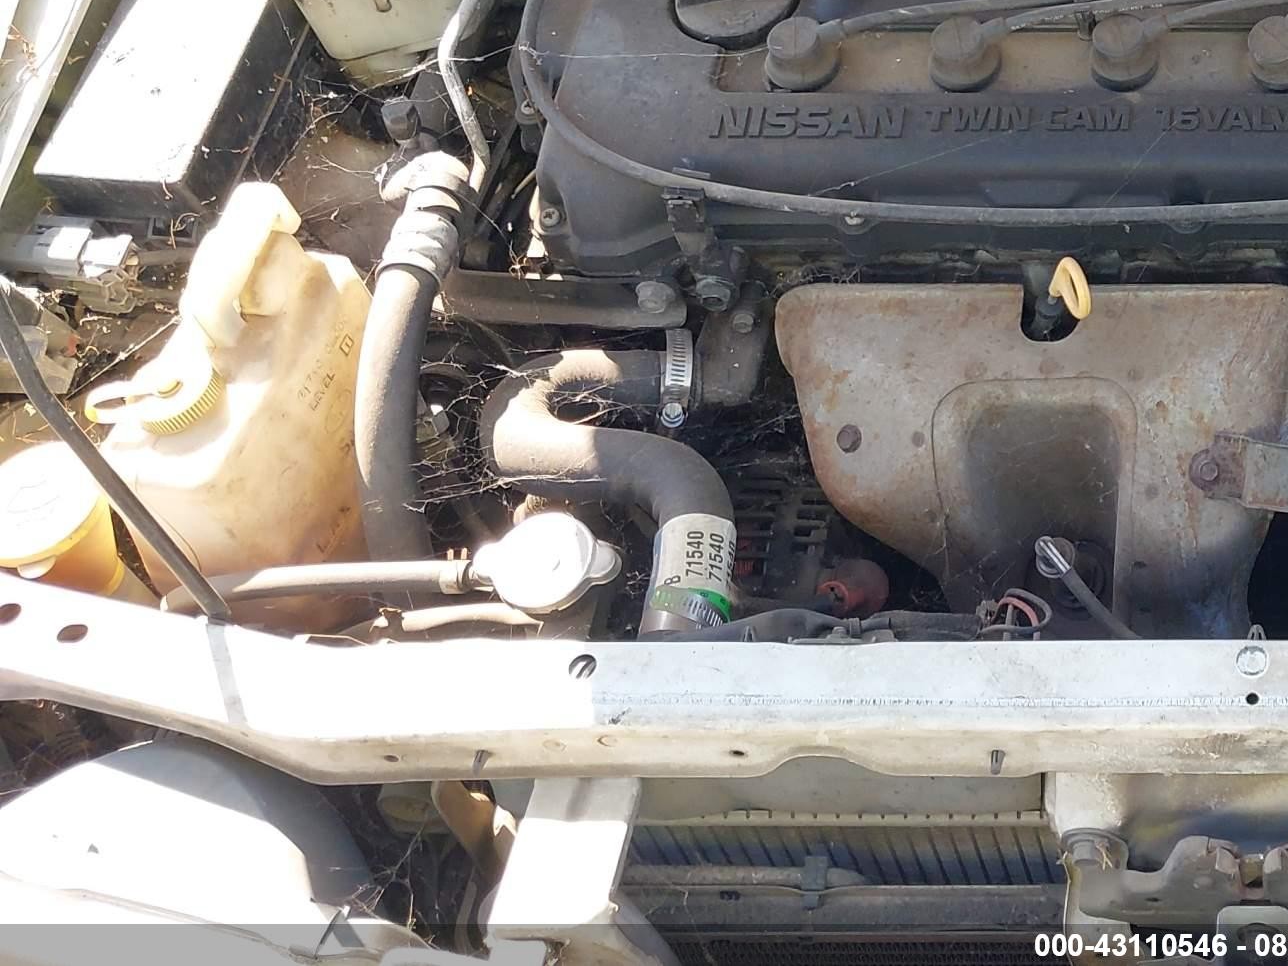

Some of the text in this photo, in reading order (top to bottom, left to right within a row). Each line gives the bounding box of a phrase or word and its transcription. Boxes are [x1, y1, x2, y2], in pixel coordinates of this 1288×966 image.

[709, 105, 904, 138] NISSAN
[924, 106, 1031, 132] TWIN
[1046, 106, 1130, 132] CAM
[685, 530, 705, 577] 71540
[707, 533, 725, 583] 71540
